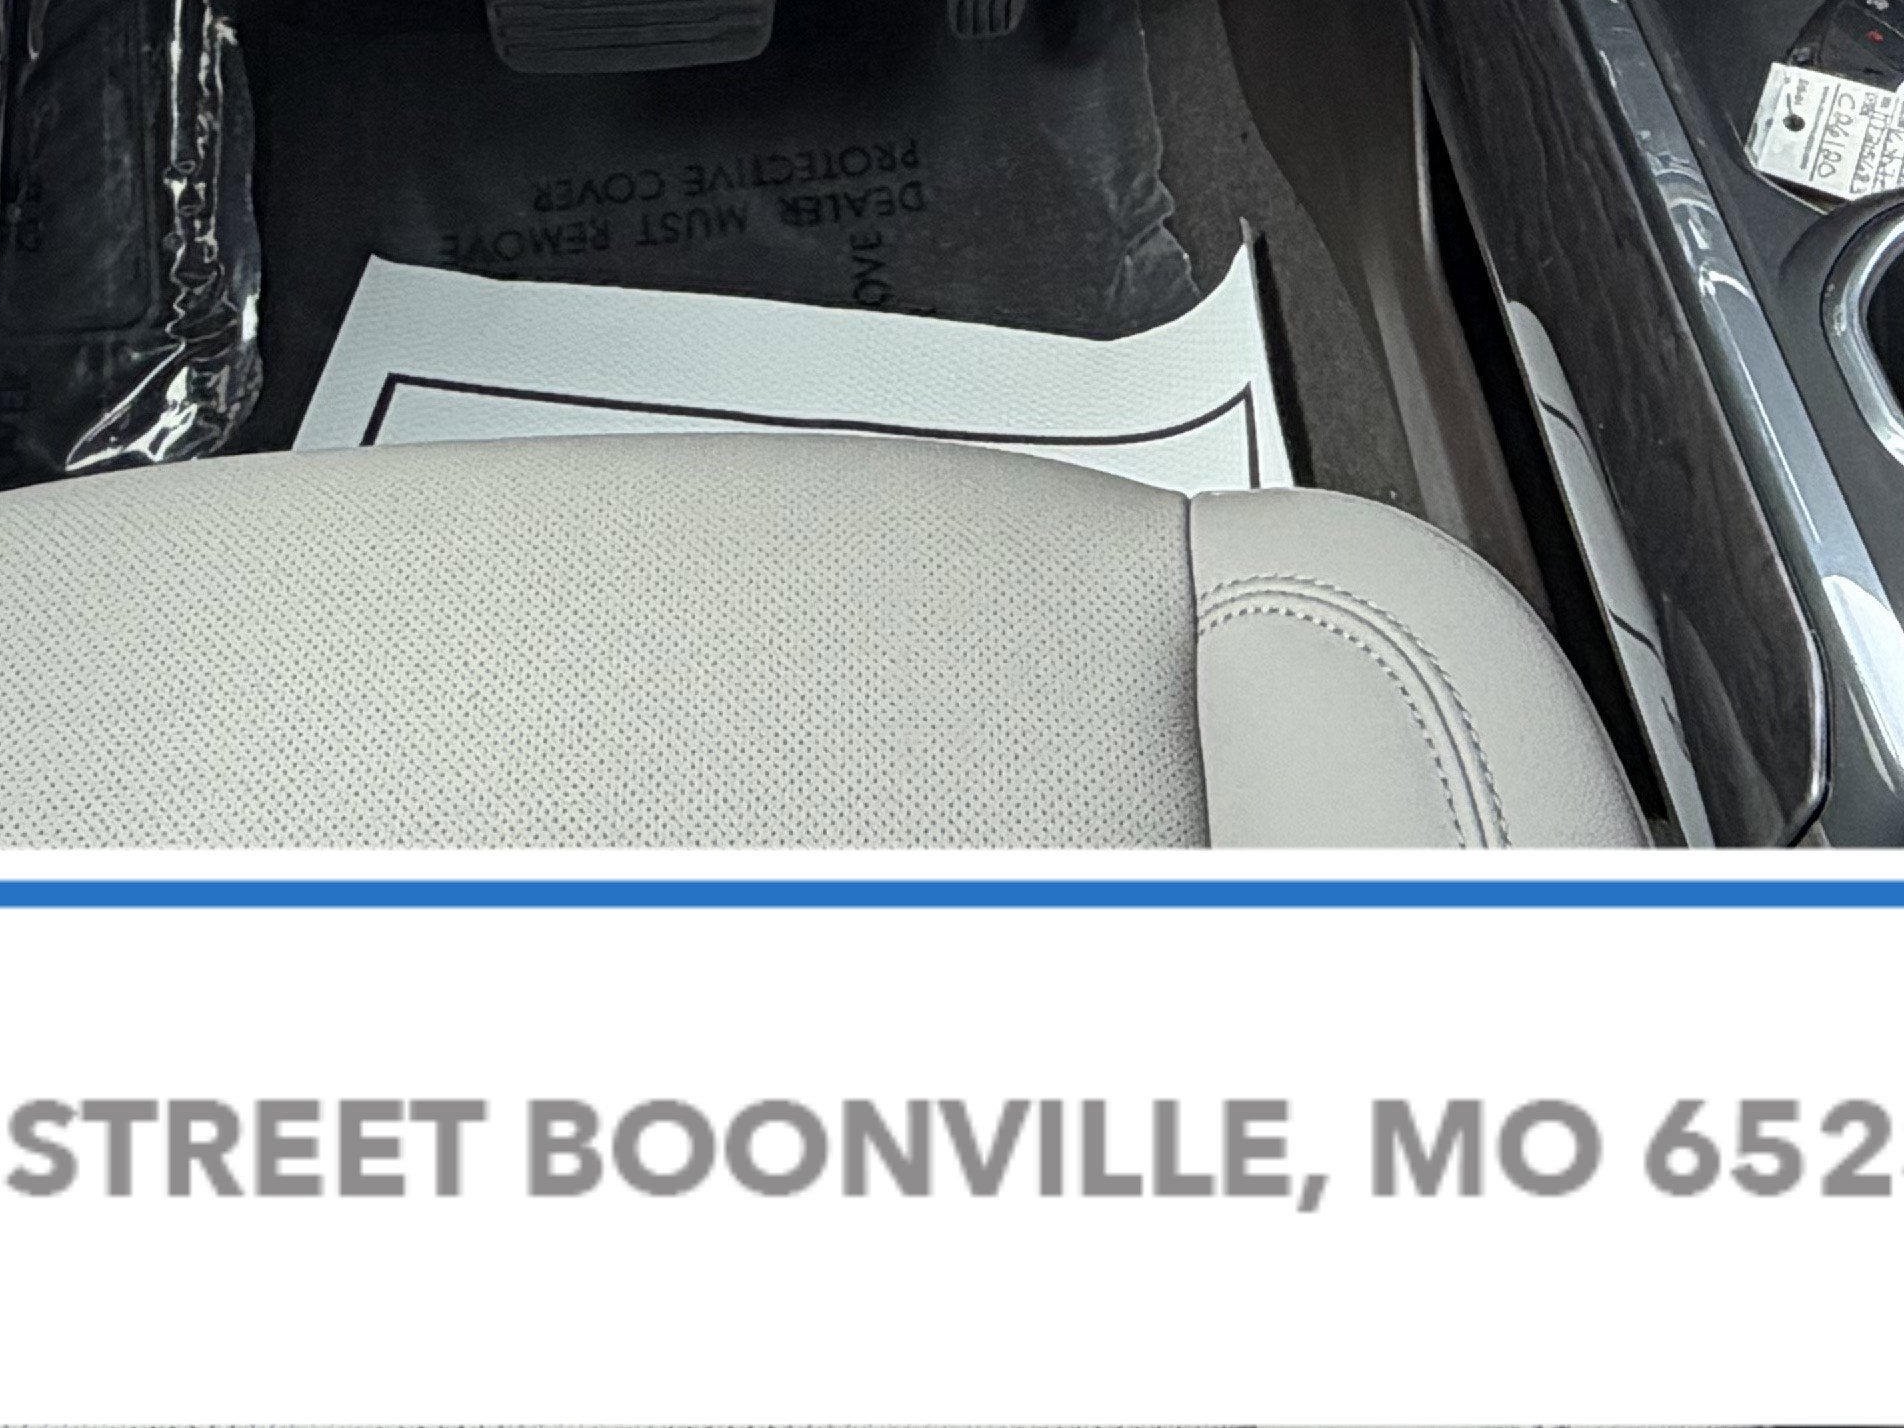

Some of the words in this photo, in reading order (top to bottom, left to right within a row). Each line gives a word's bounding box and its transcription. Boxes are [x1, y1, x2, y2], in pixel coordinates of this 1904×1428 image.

[532, 168, 666, 213] COVER
[682, 138, 921, 199] PROTECTIVE
[636, 200, 748, 247] MUST
[777, 179, 925, 228] DEALER
[440, 221, 612, 263] REMOVE
